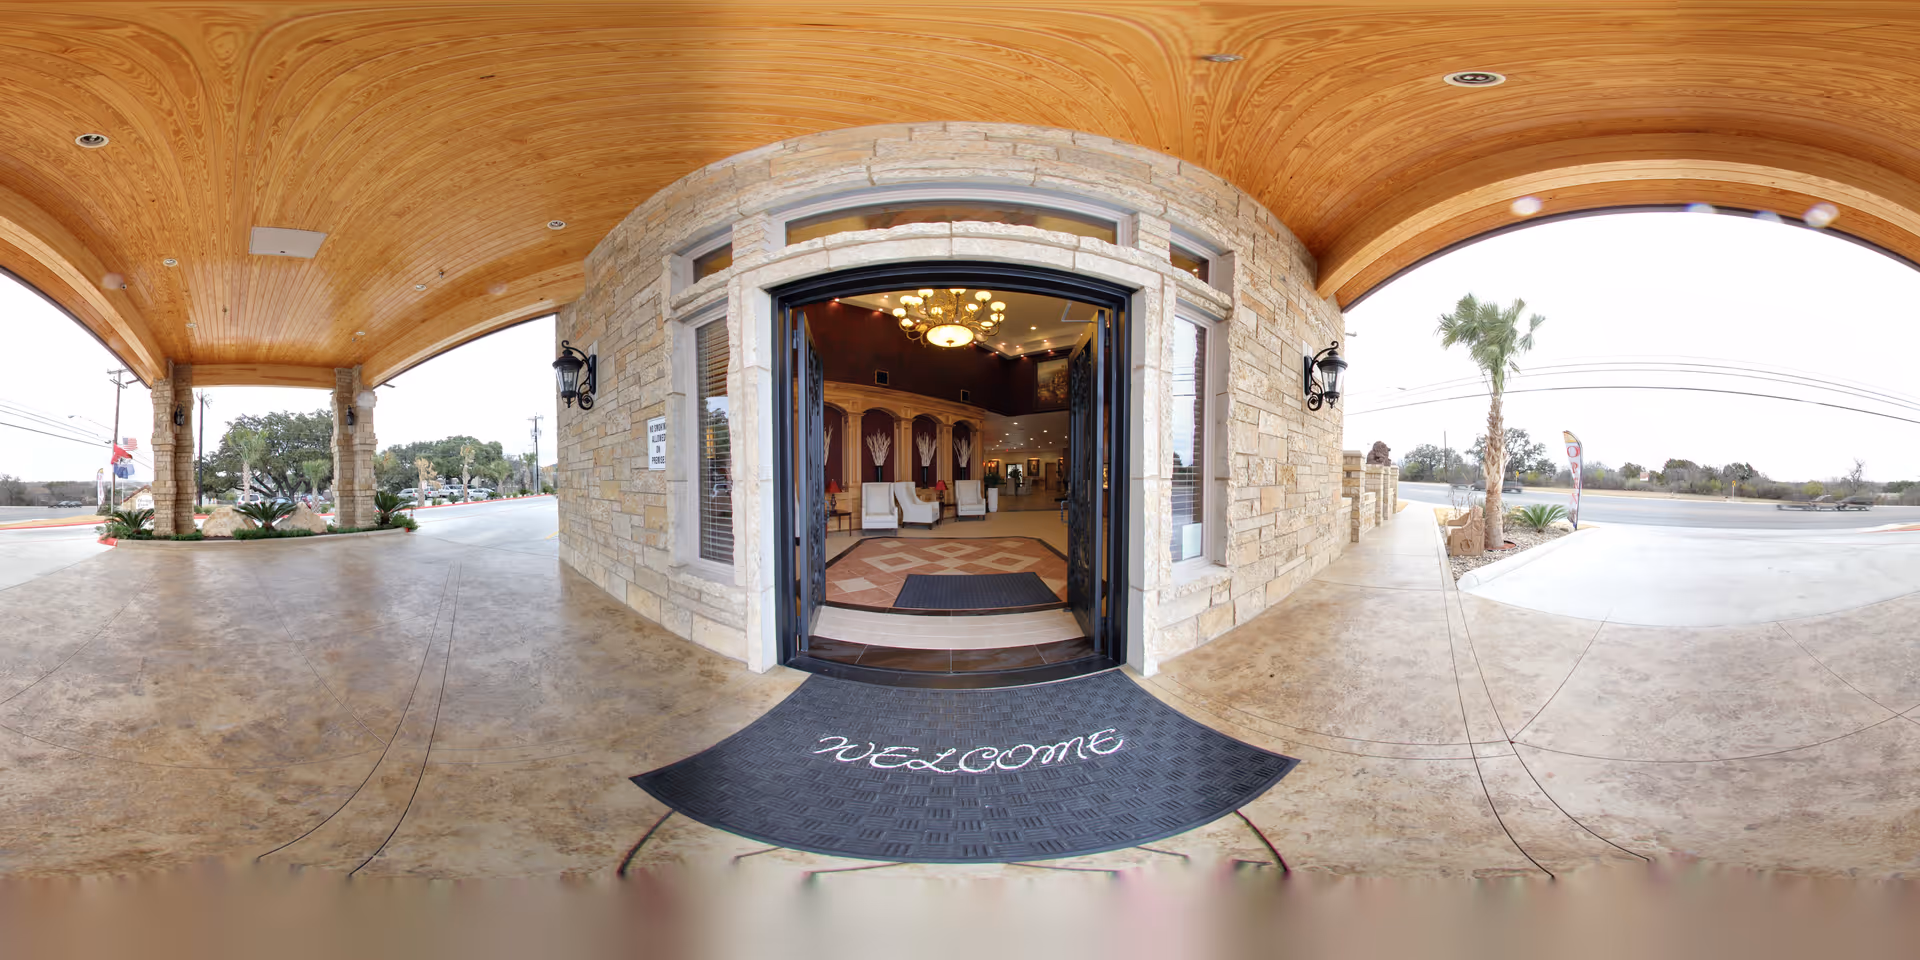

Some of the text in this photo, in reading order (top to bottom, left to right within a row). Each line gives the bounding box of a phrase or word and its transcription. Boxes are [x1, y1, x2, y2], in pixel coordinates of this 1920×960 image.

[654, 422, 666, 433] SMOKIN
[652, 433, 666, 443] ALLOWED
[656, 445, 660, 454] ON
[651, 455, 666, 465] PREMISE
[813, 728, 1124, 773] WELCOME
